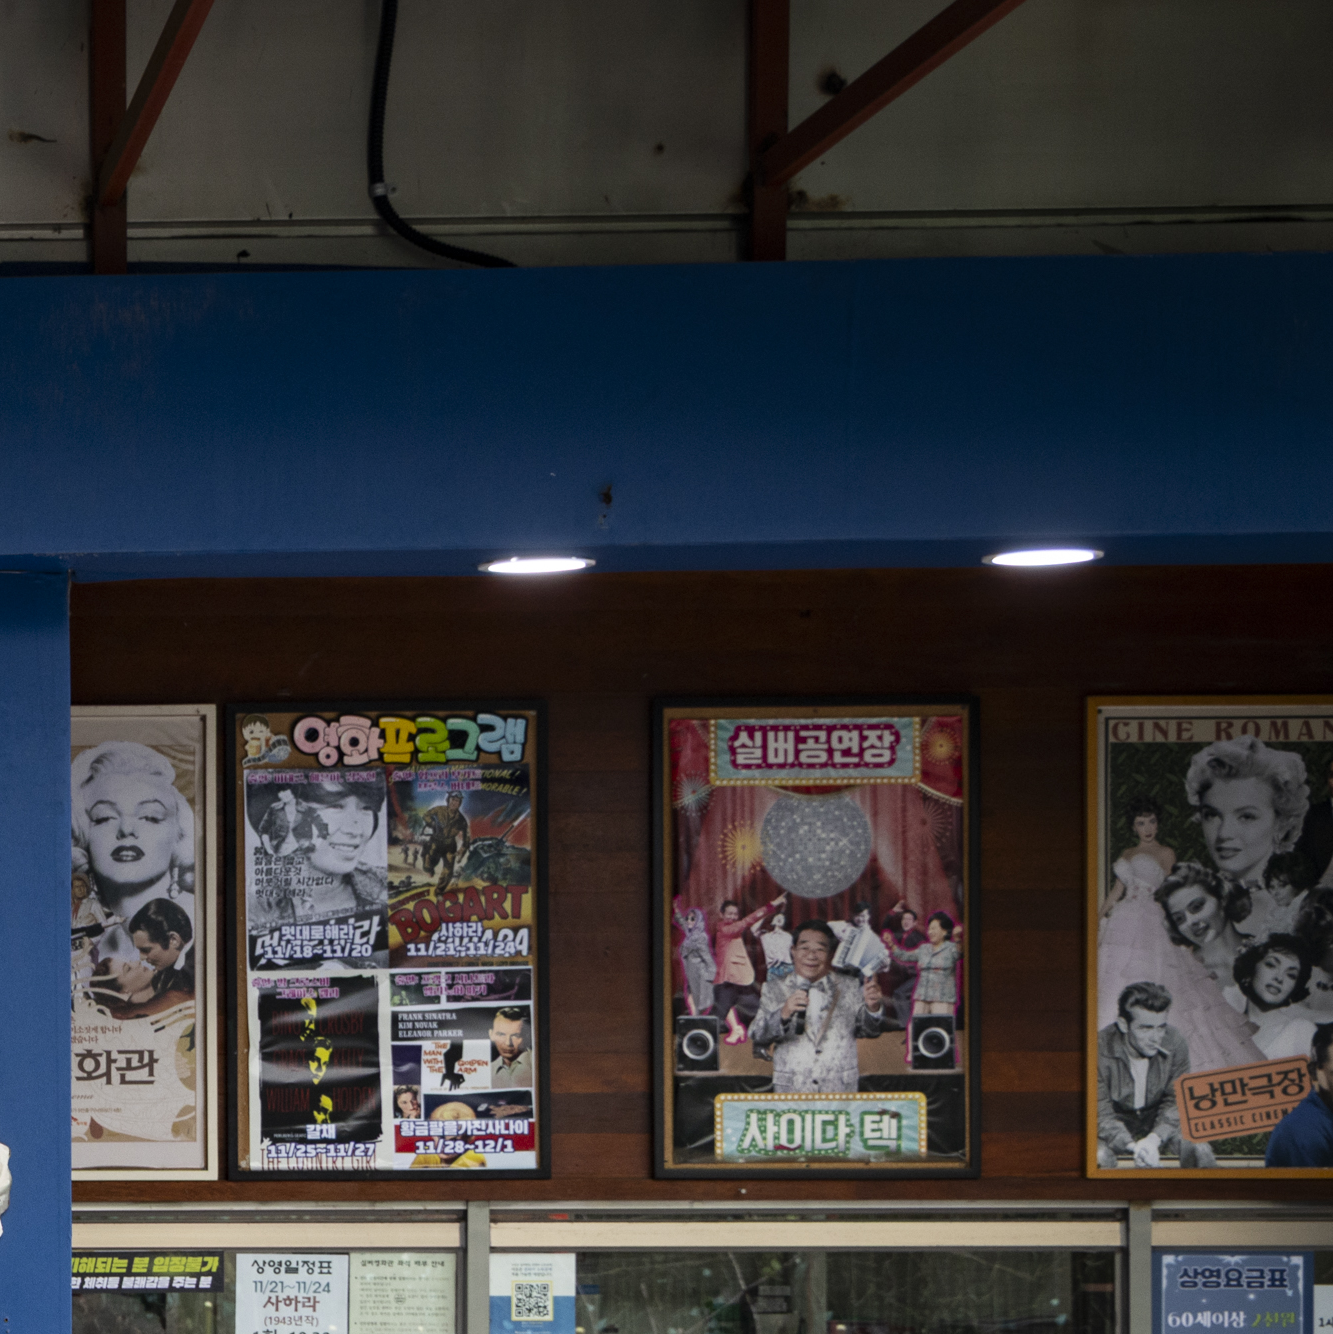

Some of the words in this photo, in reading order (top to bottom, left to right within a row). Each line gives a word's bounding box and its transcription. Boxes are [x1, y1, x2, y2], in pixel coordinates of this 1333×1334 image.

[1111, 720, 1194, 742] CINE
[291, 713, 529, 767] 영화프로그램
[731, 725, 896, 767] 실버공연장
[389, 886, 529, 941] BOGART
[281, 924, 355, 941] 멋대로해라
[440, 922, 483, 938] 사하라
[264, 943, 373, 958] 11/18~11/20
[398, 1012, 423, 1021] FRANK
[424, 1012, 457, 1021] SINATRA
[398, 1021, 413, 1029] KIM
[414, 1021, 438, 1029] NOVAK
[398, 1030, 431, 1038] ELEANOR
[433, 1029, 463, 1038] PARKER
[1188, 1067, 1306, 1111] 낭만극장
[306, 1124, 337, 1140] 갈채
[400, 1119, 530, 1137] 황금팔을가진사나이
[740, 1110, 852, 1153] 사이다
[1194, 1115, 1246, 1132] CLASSIC
[267, 1143, 376, 1158] 11/25~11/27
[415, 1138, 515, 1154] 11/28~12/1
[152, 1256, 220, 1273] 입장불가
[251, 1259, 332, 1275] 상영일정표
[1178, 1267, 1289, 1289] 상영요금표
[252, 1280, 331, 1294] 11/21~11/24
[263, 1295, 320, 1312] 사하라
[264, 1315, 319, 1328] (1943년작)
[1167, 1310, 1247, 1329] 60세이상
